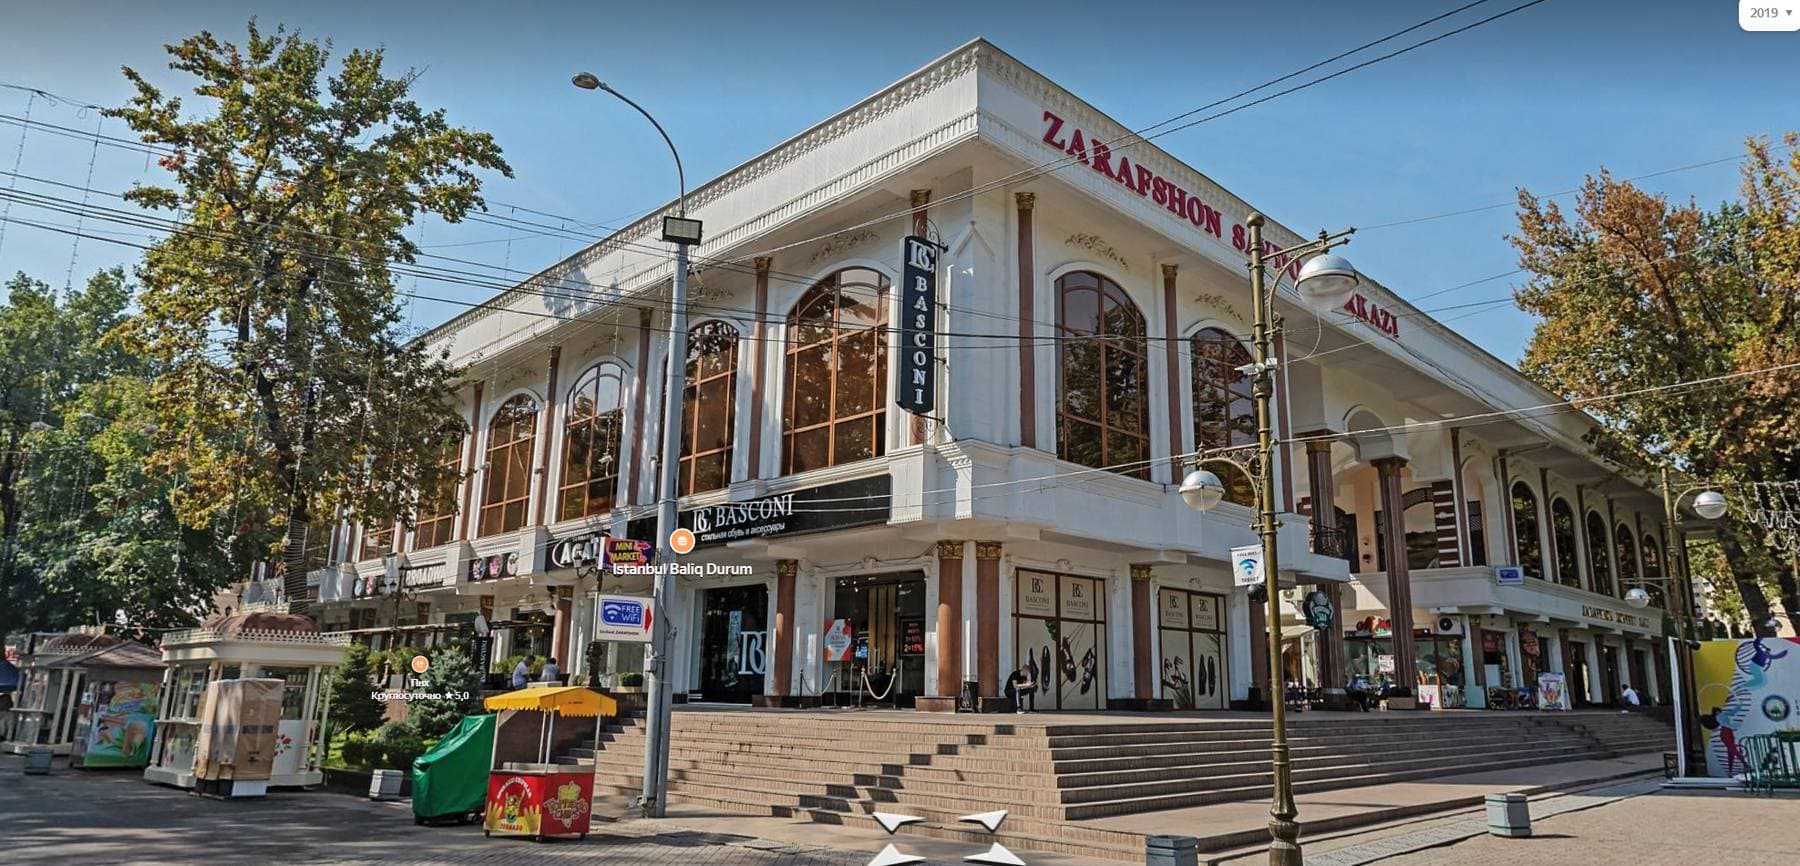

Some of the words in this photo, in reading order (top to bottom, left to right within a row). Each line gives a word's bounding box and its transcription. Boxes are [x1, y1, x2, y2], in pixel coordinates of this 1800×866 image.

[1043, 110, 1222, 239] ZARAFSHON
[912, 275, 929, 404] BASCONI
[715, 493, 795, 528] BASCONI
[728, 527, 745, 539] обувь
[615, 541, 634, 551] MINI
[611, 551, 641, 562] MARKET
[621, 605, 640, 614] FREE
